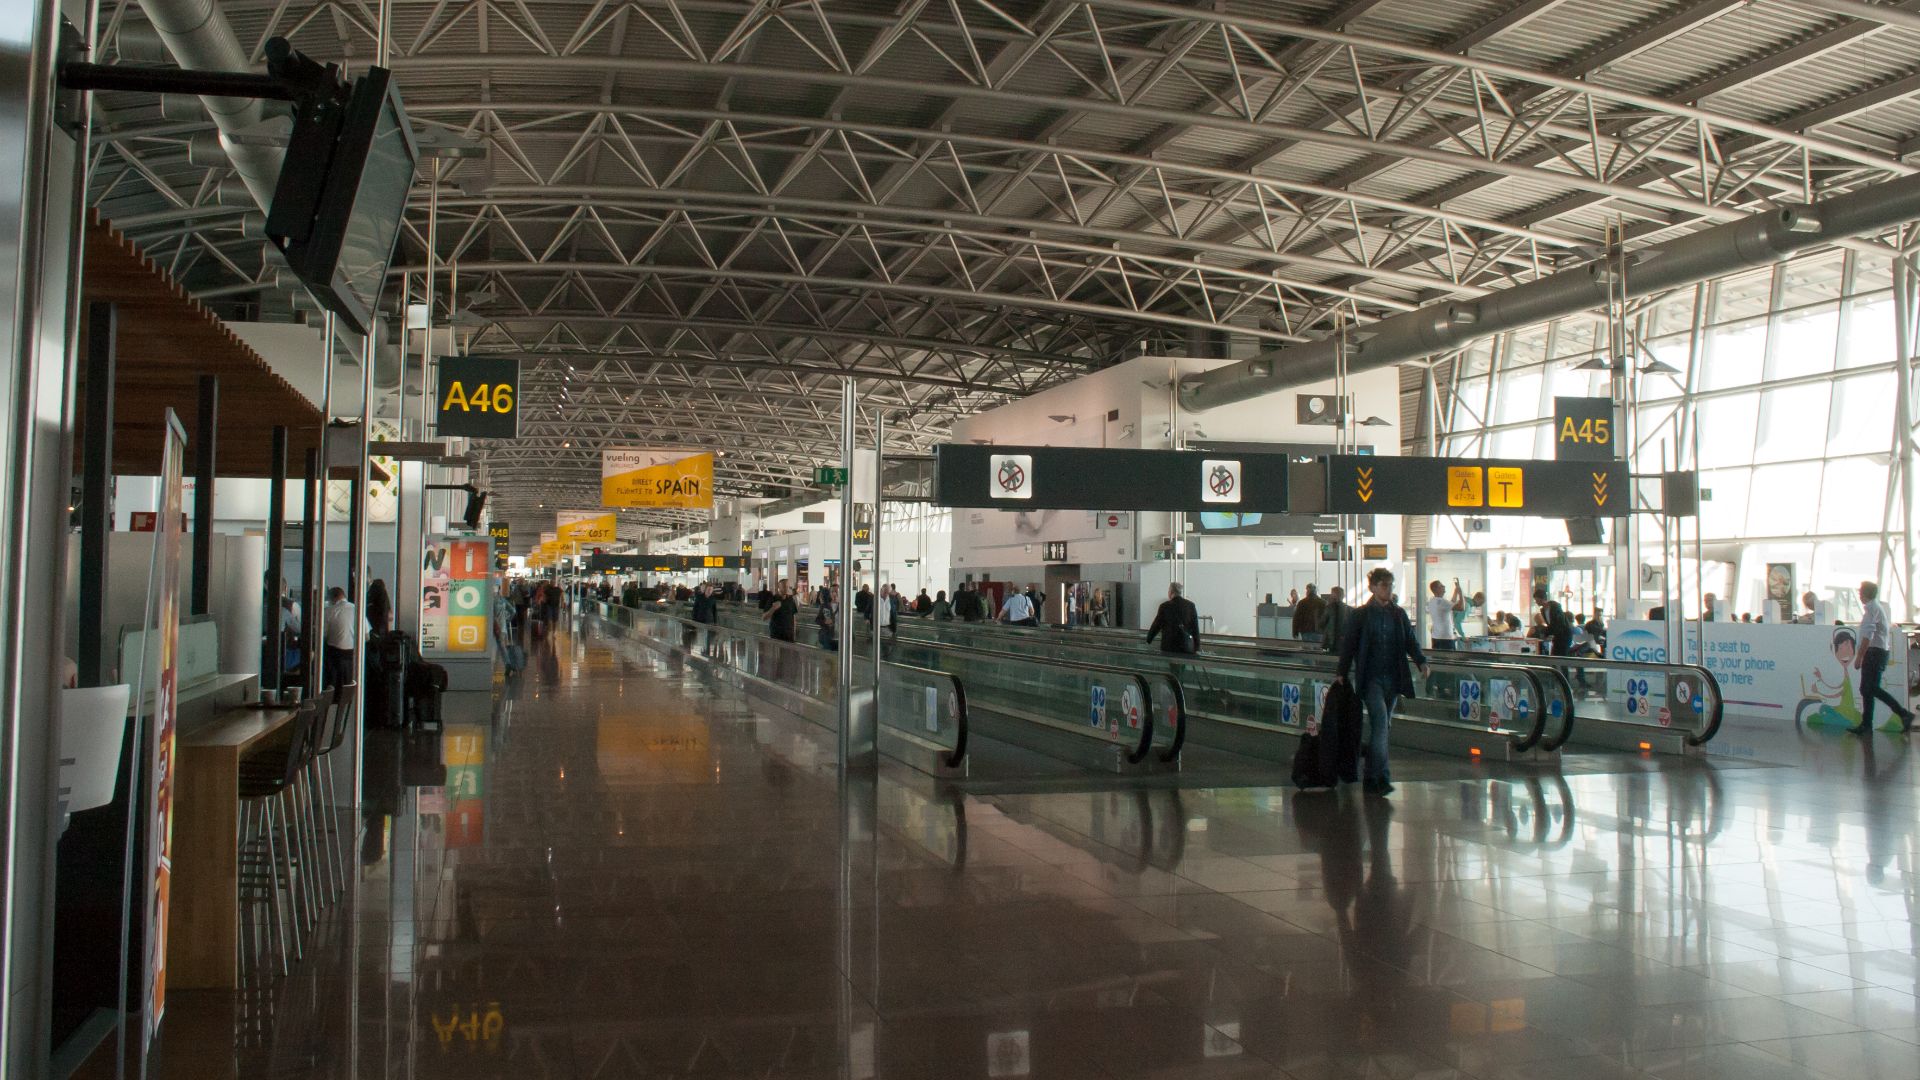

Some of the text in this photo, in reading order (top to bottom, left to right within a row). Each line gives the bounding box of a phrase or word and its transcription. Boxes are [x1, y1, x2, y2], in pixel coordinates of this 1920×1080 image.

[443, 381, 514, 413] A46
[1560, 416, 1610, 444] A45
[606, 452, 640, 465] vueling
[1494, 471, 1516, 479] Gates
[656, 477, 700, 496] SPAIN
[1461, 478, 1471, 492] A
[1497, 481, 1513, 503] T
[589, 530, 609, 538] COST
[1687, 638, 1750, 653] Tae a seat to
[1721, 657, 1742, 669] your
[1744, 657, 1775, 671] phone
[1731, 672, 1753, 685] here
